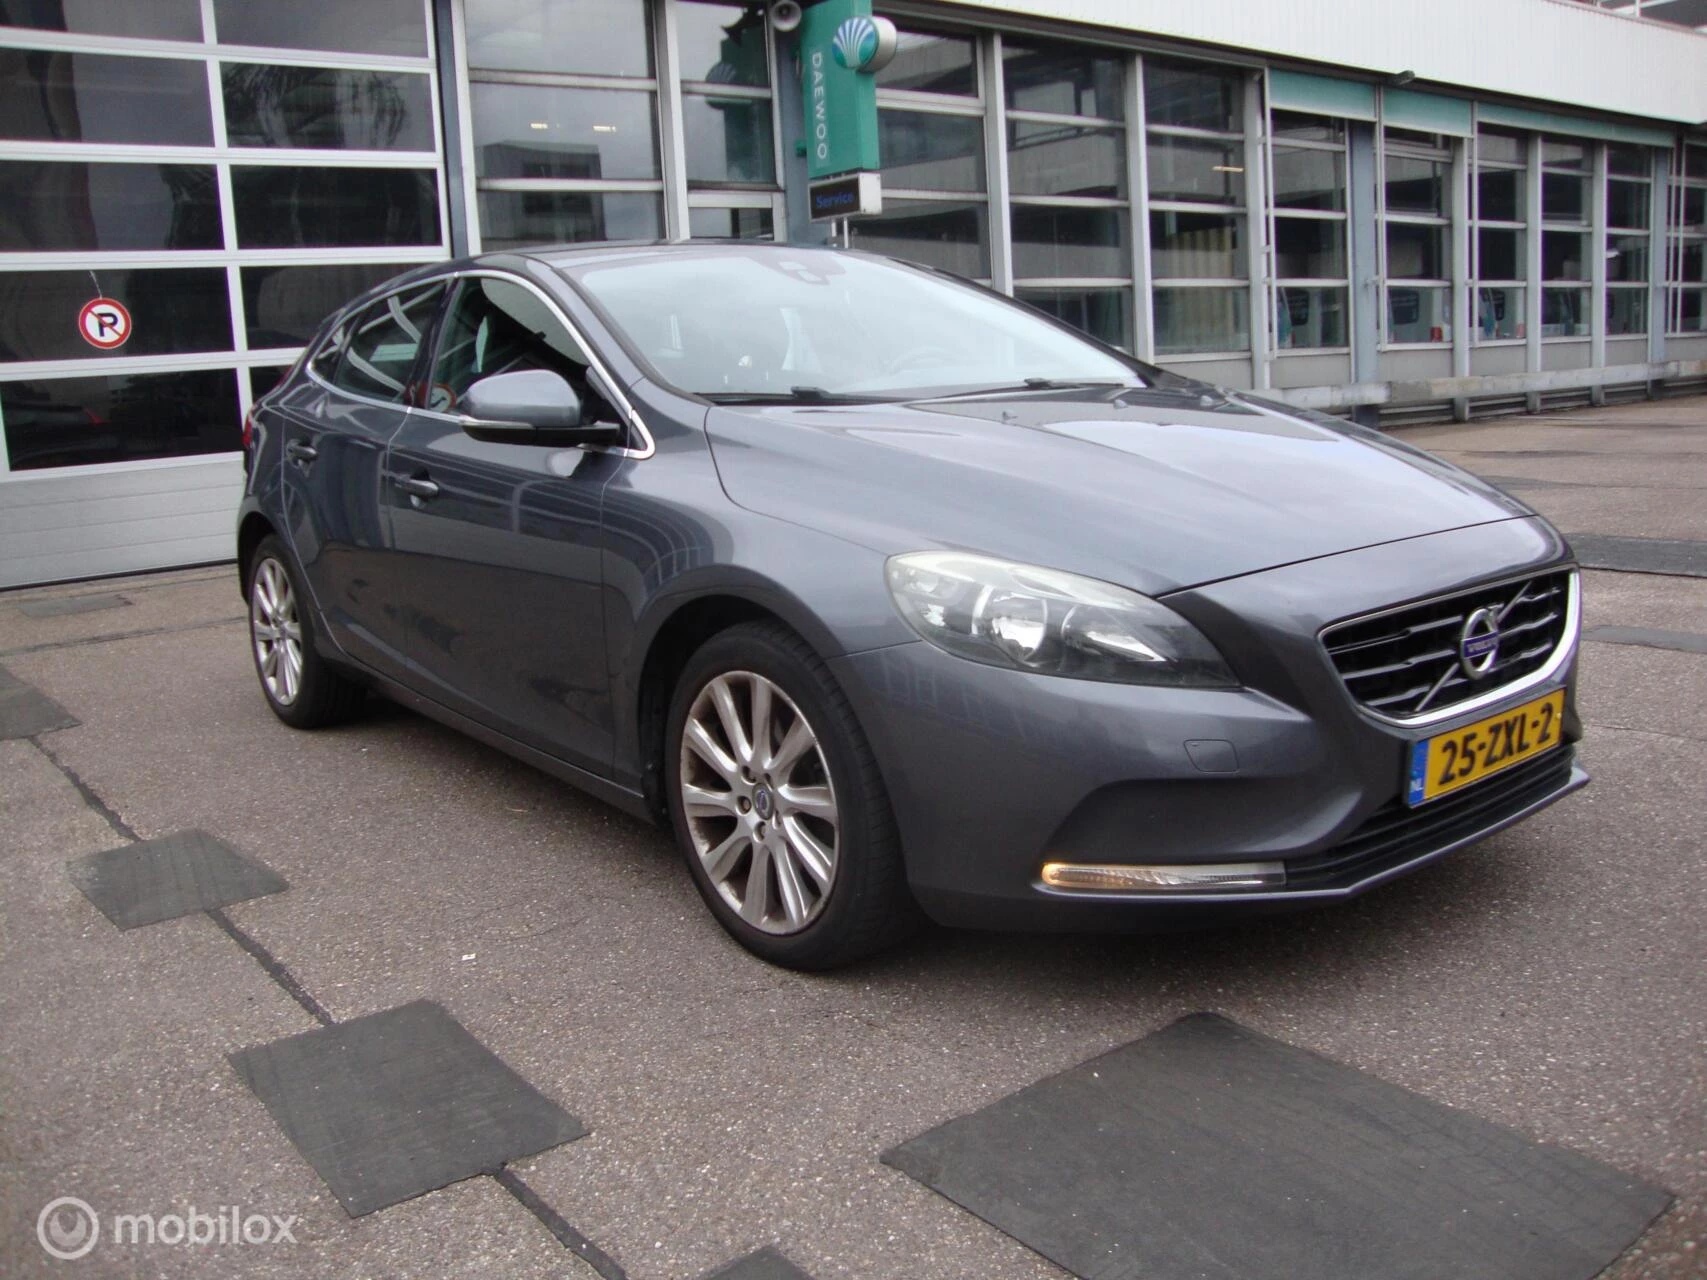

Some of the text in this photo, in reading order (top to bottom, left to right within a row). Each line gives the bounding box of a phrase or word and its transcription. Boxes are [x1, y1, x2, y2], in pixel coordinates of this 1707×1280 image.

[811, 52, 828, 160] DAEWOO
[815, 192, 855, 209] Service
[1438, 702, 1553, 786] 25-ZXL-2
